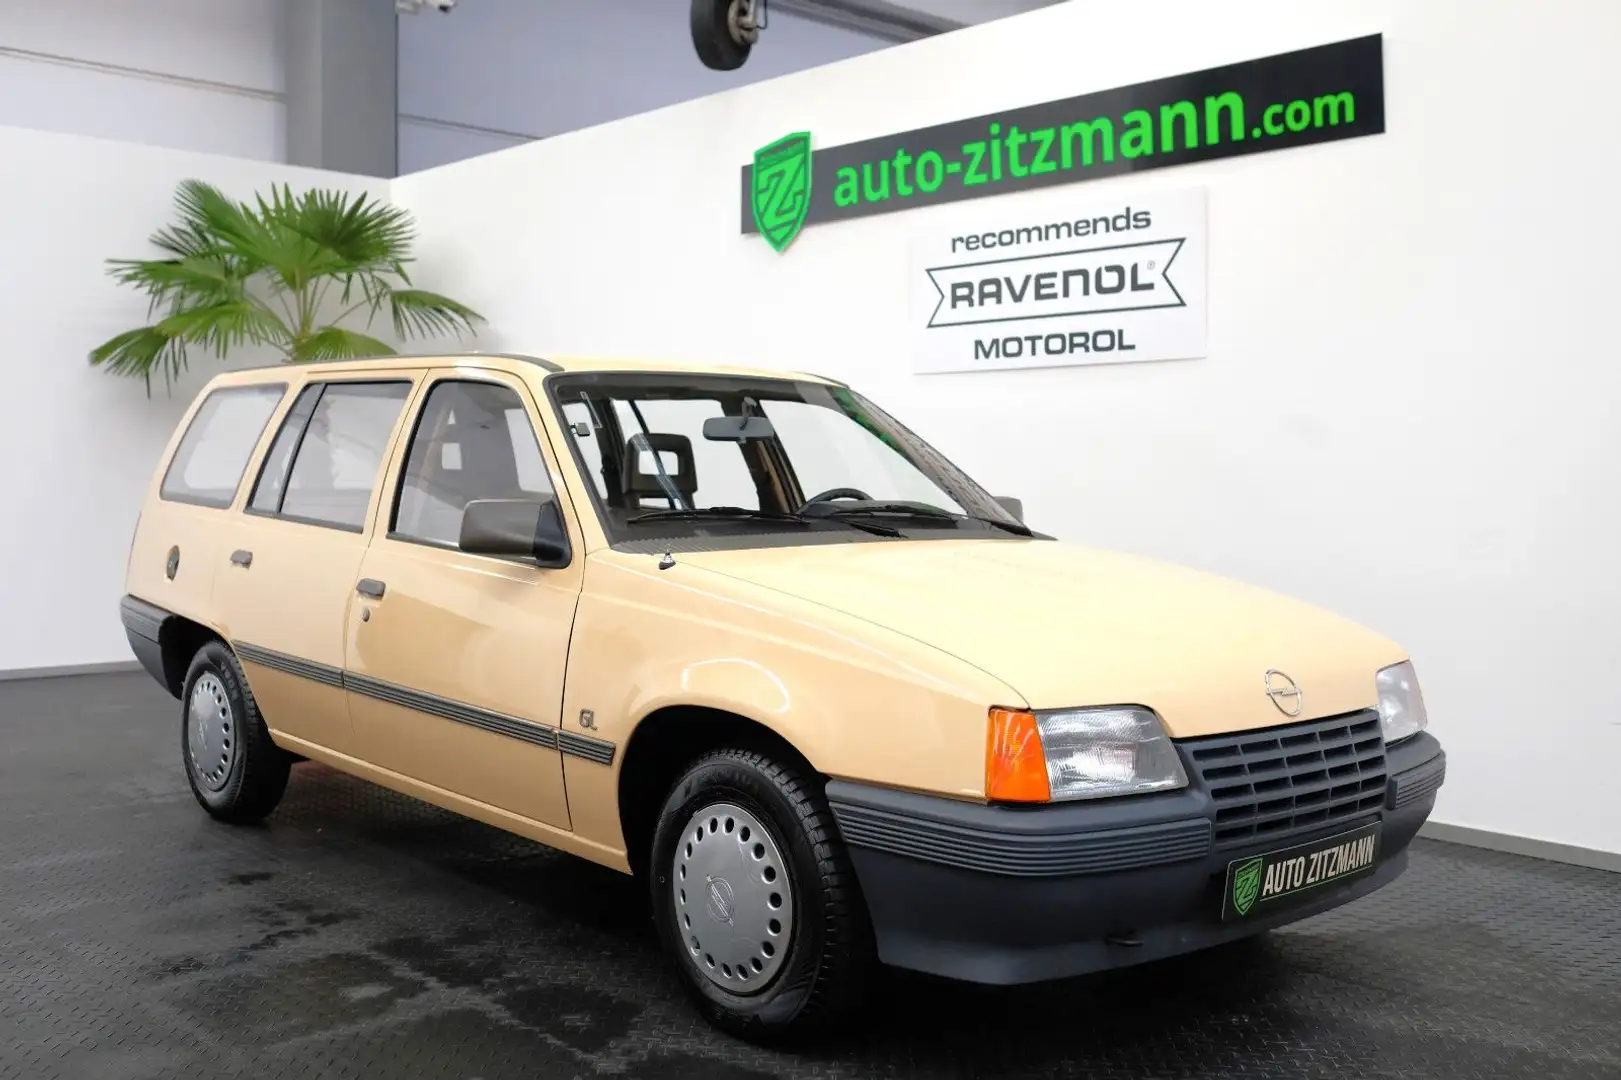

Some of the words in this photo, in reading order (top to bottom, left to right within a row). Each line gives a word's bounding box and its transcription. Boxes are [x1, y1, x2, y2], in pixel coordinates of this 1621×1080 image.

[833, 91, 1355, 208] auto-zitzmann.com
[952, 206, 1152, 253] recommends
[974, 329, 1136, 360] MOTOROL
[1262, 855, 1306, 897] AUTO
[1306, 833, 1376, 885] ZITZMANN
